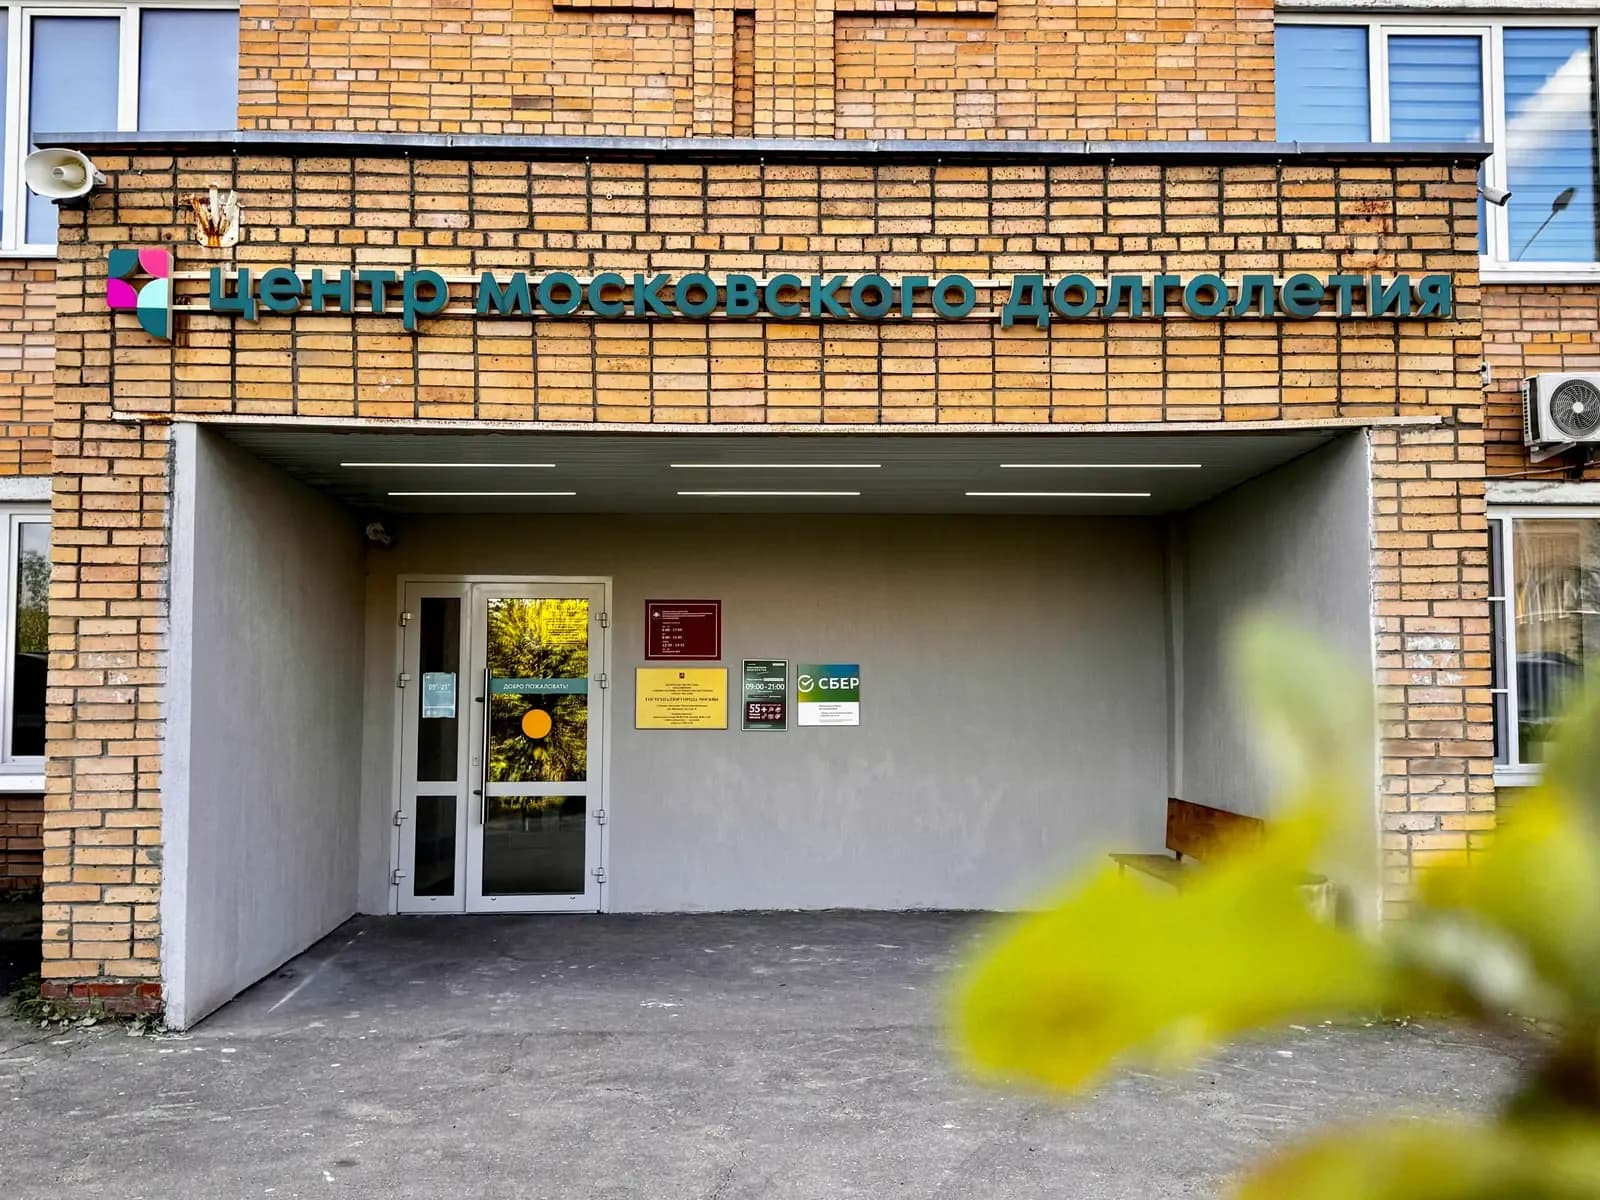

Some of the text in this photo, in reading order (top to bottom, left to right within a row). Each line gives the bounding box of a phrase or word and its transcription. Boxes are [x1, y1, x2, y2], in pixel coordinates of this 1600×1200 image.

[209, 266, 1454, 332] центр московского долголетия
[818, 677, 860, 690] СБЕР
